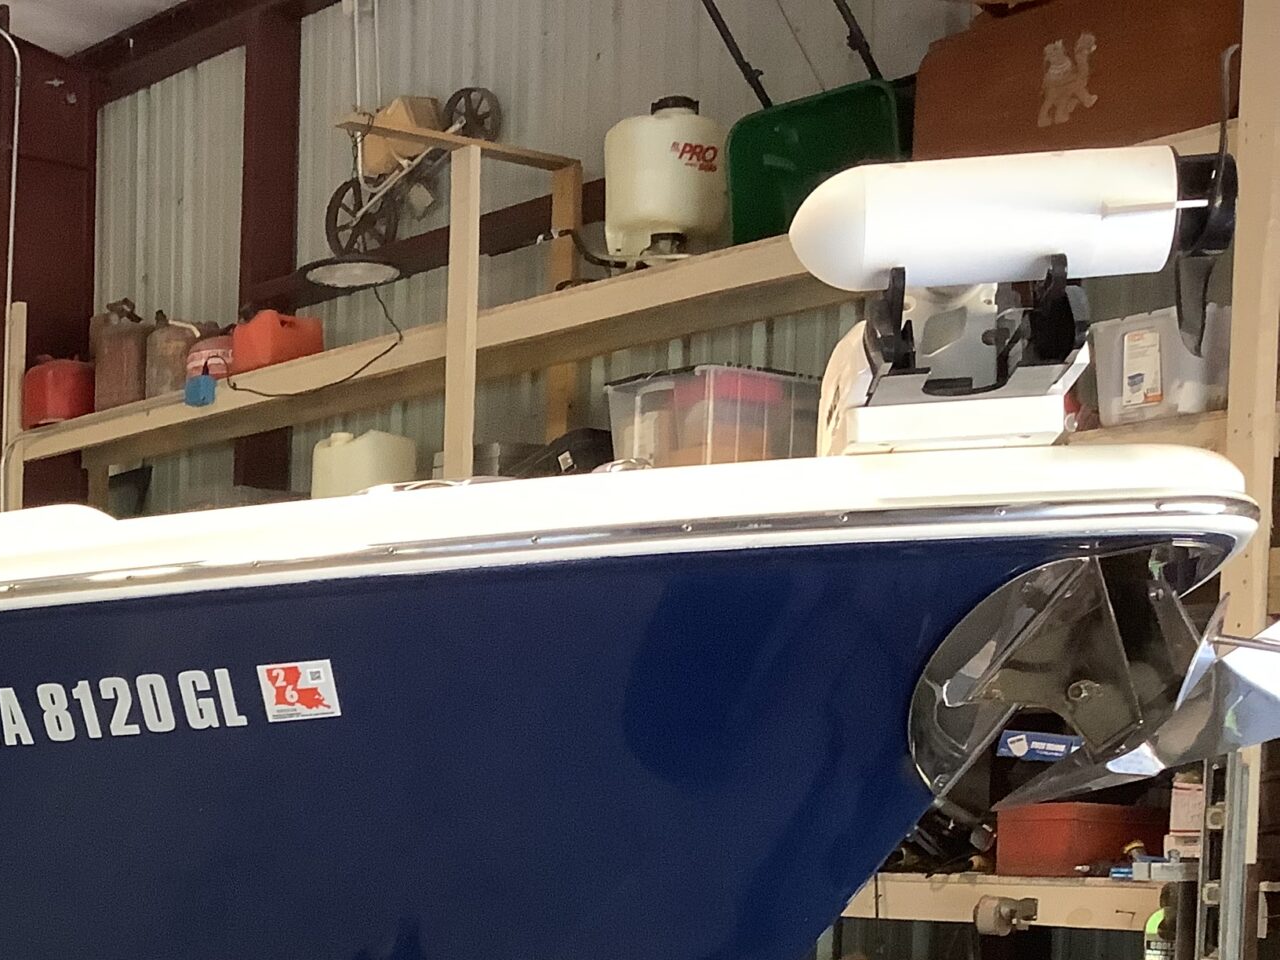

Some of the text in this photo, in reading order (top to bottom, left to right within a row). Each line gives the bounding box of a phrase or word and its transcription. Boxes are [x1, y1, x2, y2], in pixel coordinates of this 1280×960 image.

[679, 142, 718, 163] PRO
[36, 673, 177, 742] 8120
[178, 668, 248, 730] GL
